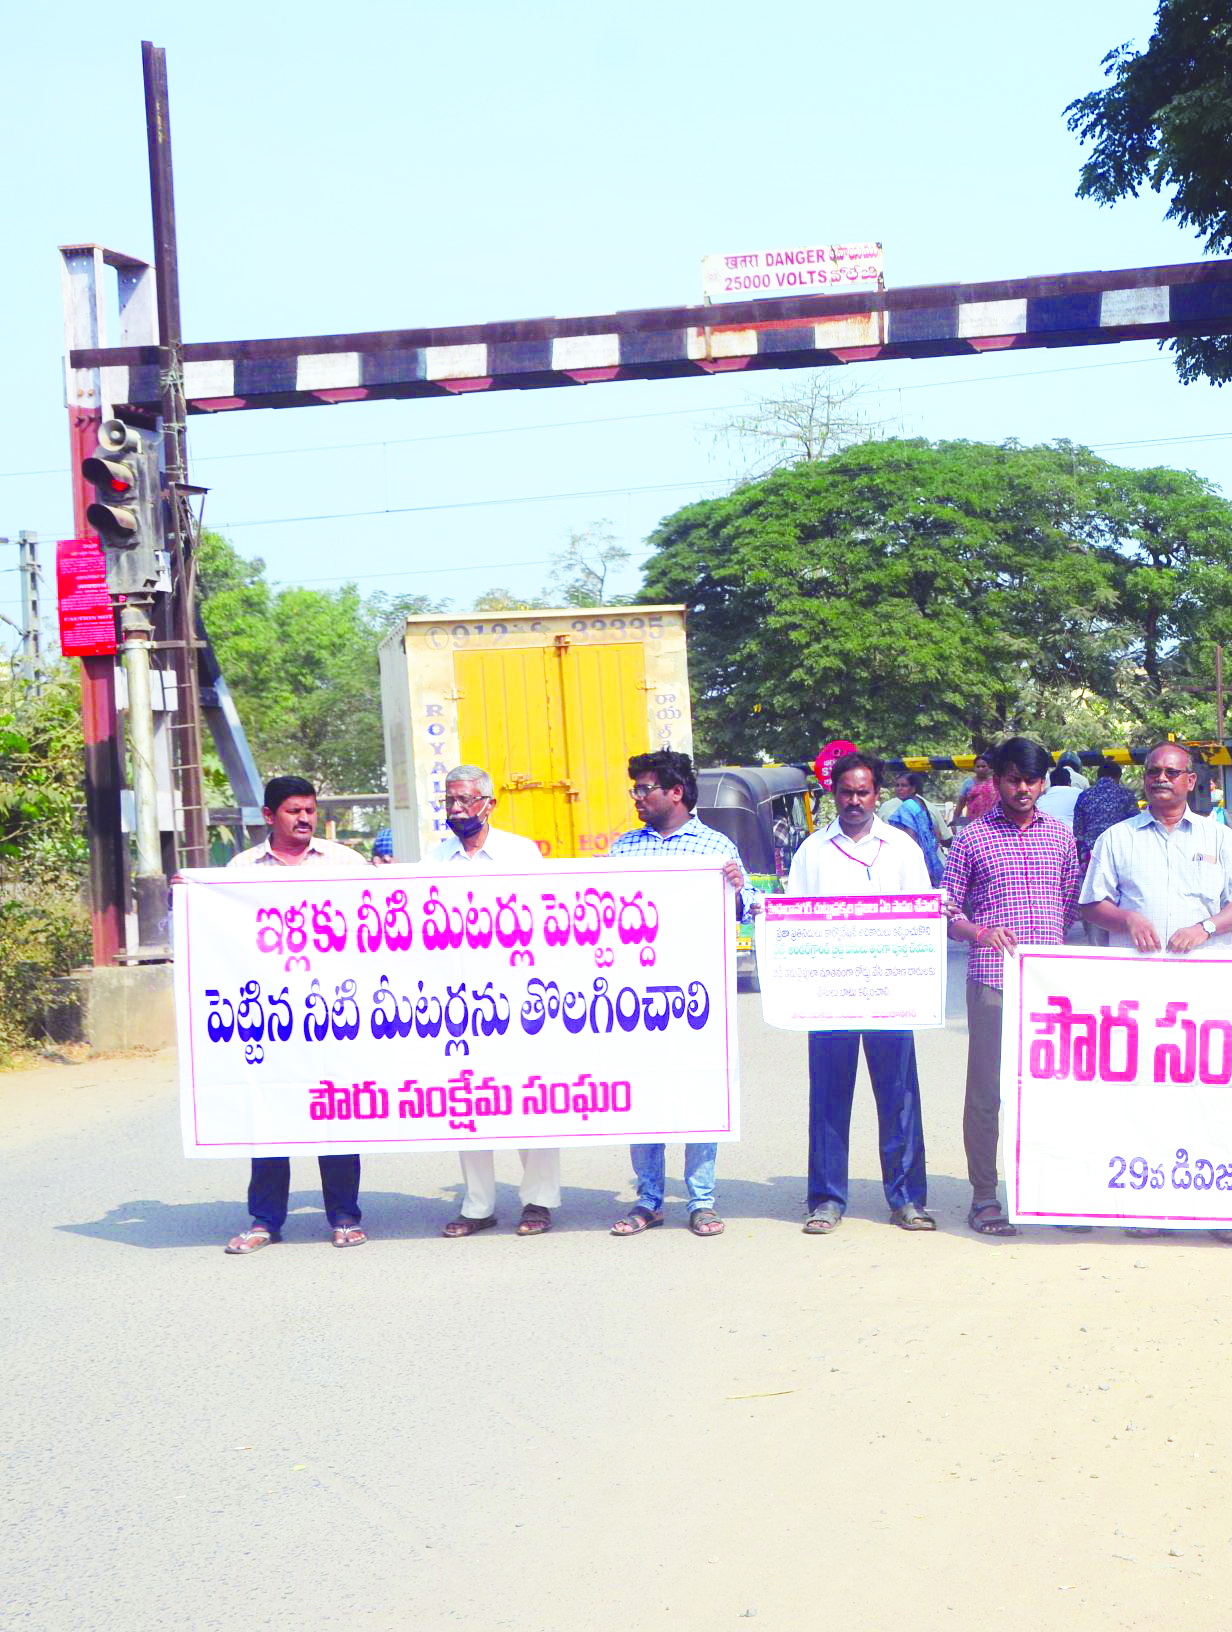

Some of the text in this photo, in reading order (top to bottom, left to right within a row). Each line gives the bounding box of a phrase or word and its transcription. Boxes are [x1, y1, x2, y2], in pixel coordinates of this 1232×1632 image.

[724, 255, 758, 269] खतरा
[765, 250, 825, 266] DANGER
[725, 274, 770, 291] 25000
[776, 270, 827, 286] VOLTS
[356, 889, 413, 953] నీటి
[422, 885, 535, 967] మీటర్లు
[541, 887, 659, 968] పెట్టొద్దు
[206, 973, 710, 1065] పెట్టిన నీటి మీటర్లను తొలగించాలి
[1029, 994, 1140, 1081] పౌర
[398, 1069, 513, 1132] సంక్షేమ
[522, 1073, 631, 1121] సంఘం
[1107, 1155, 1166, 1190] 29వ
